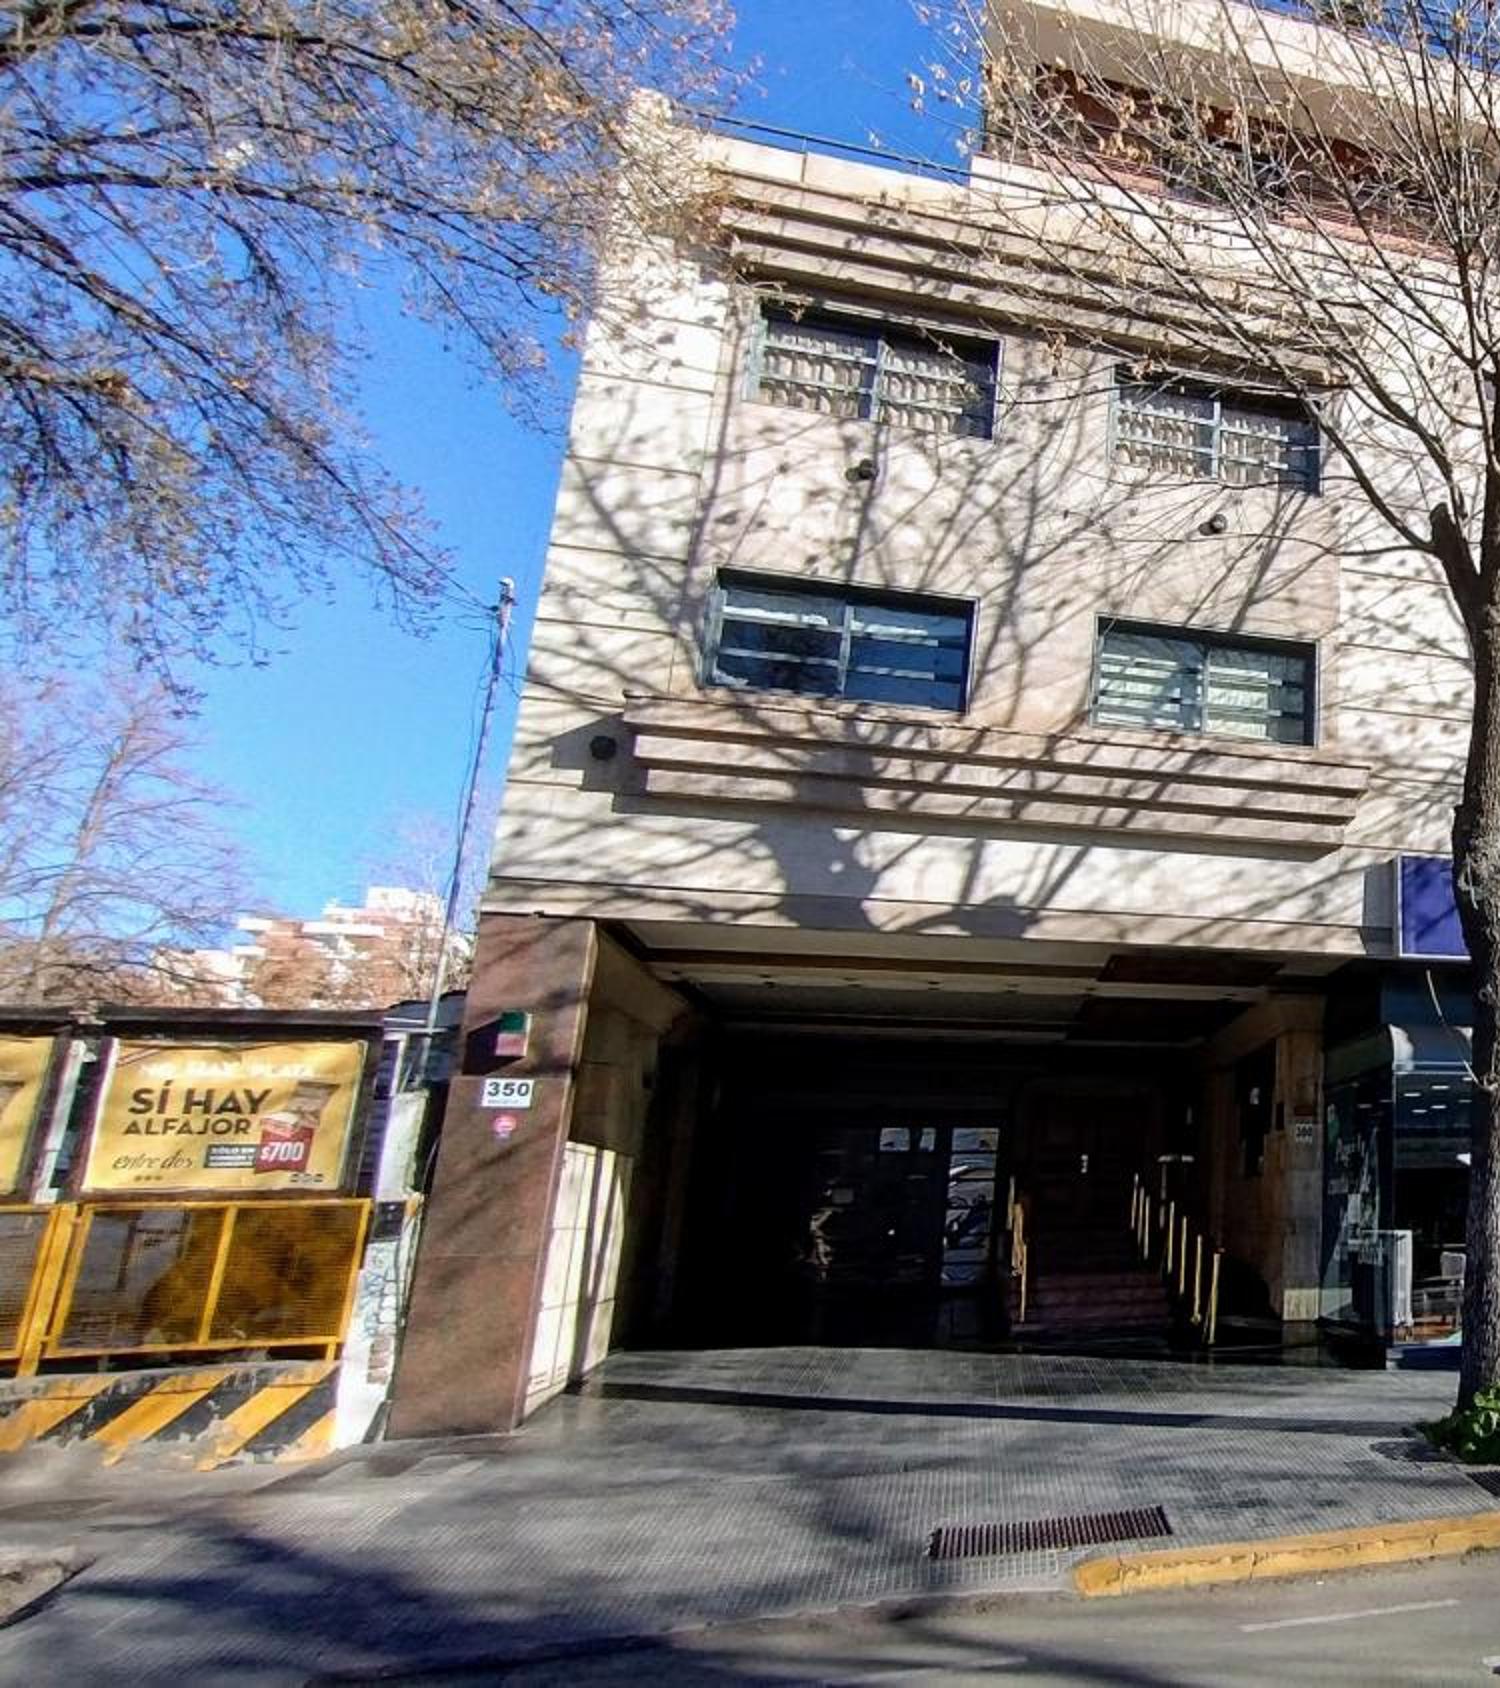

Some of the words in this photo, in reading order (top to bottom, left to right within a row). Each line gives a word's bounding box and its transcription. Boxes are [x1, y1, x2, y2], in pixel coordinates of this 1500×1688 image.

[128, 1080, 173, 1115] SÍ
[182, 1088, 272, 1115] HAY
[487, 1081, 530, 1097] 350
[124, 1118, 251, 1135] ALFAJOR
[260, 1141, 304, 1162] $700
